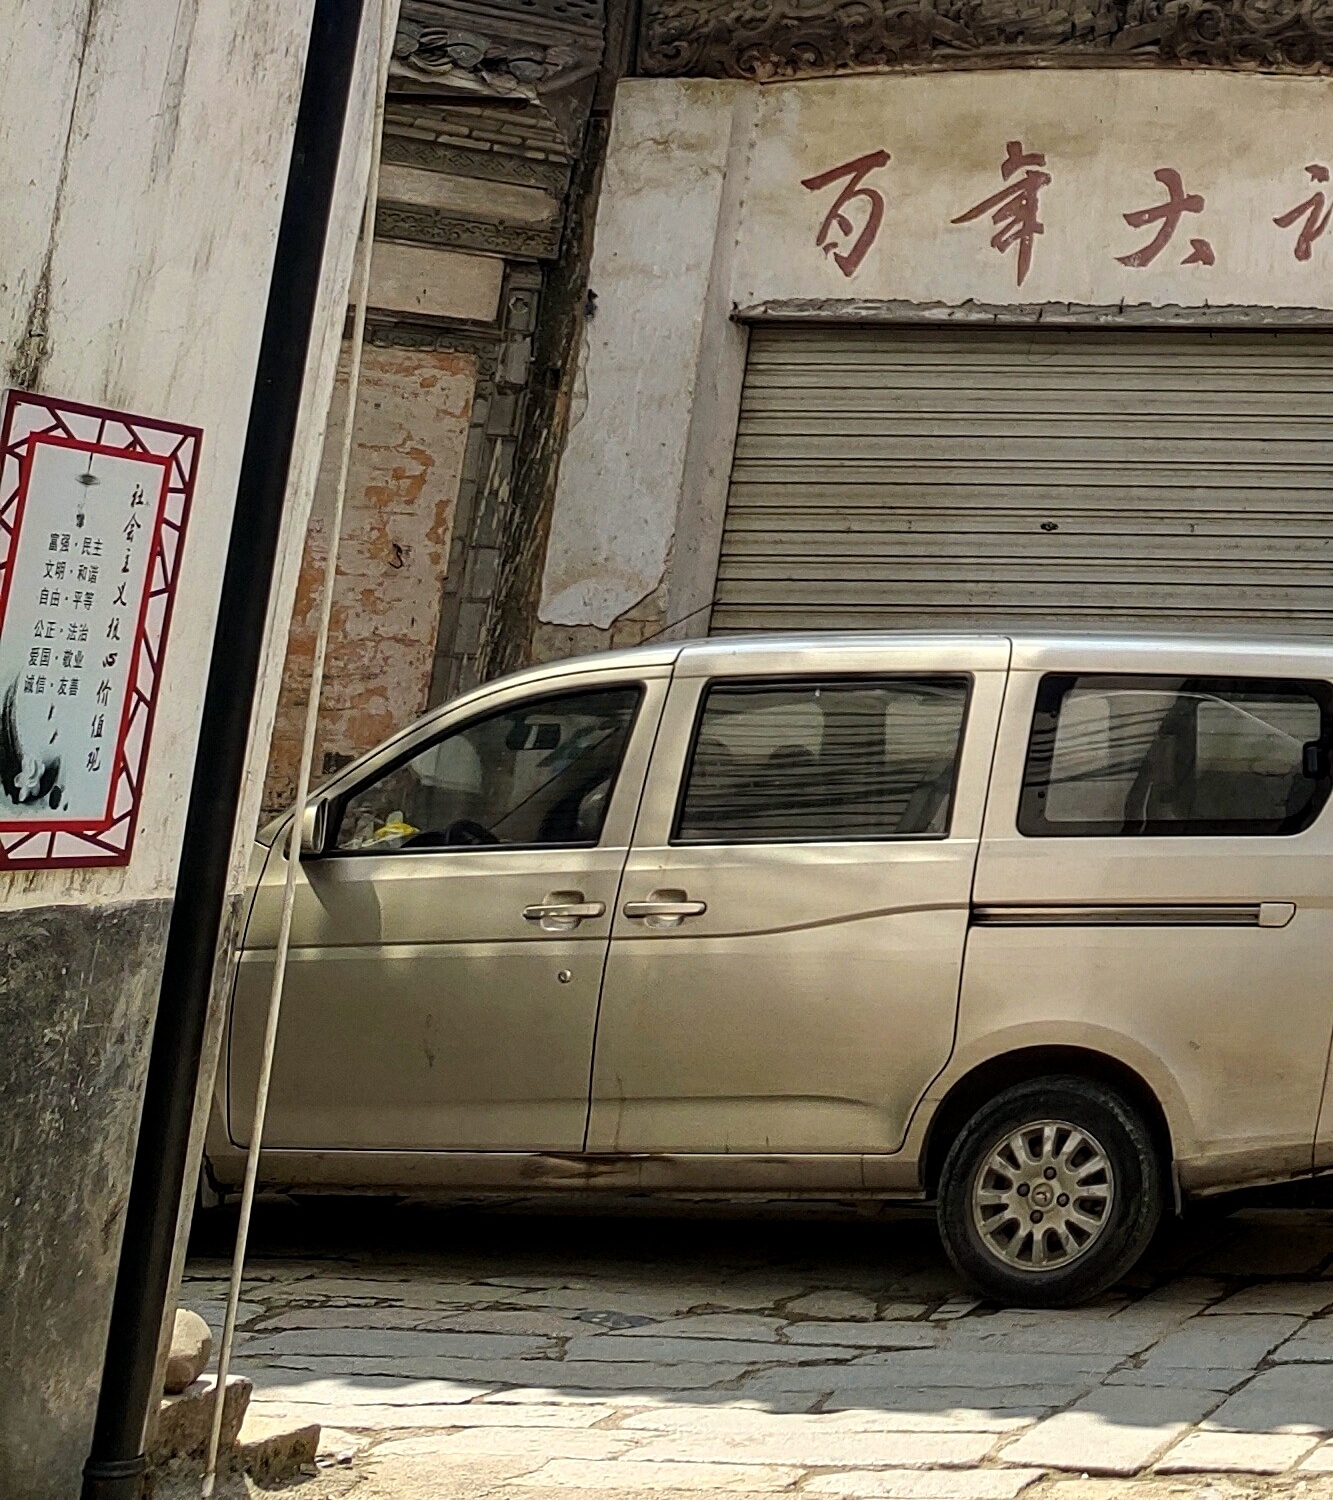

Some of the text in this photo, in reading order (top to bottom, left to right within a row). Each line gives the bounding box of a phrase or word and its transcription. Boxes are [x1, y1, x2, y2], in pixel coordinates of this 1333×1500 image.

[85, 483, 145, 773] 社会主义核心价值观
